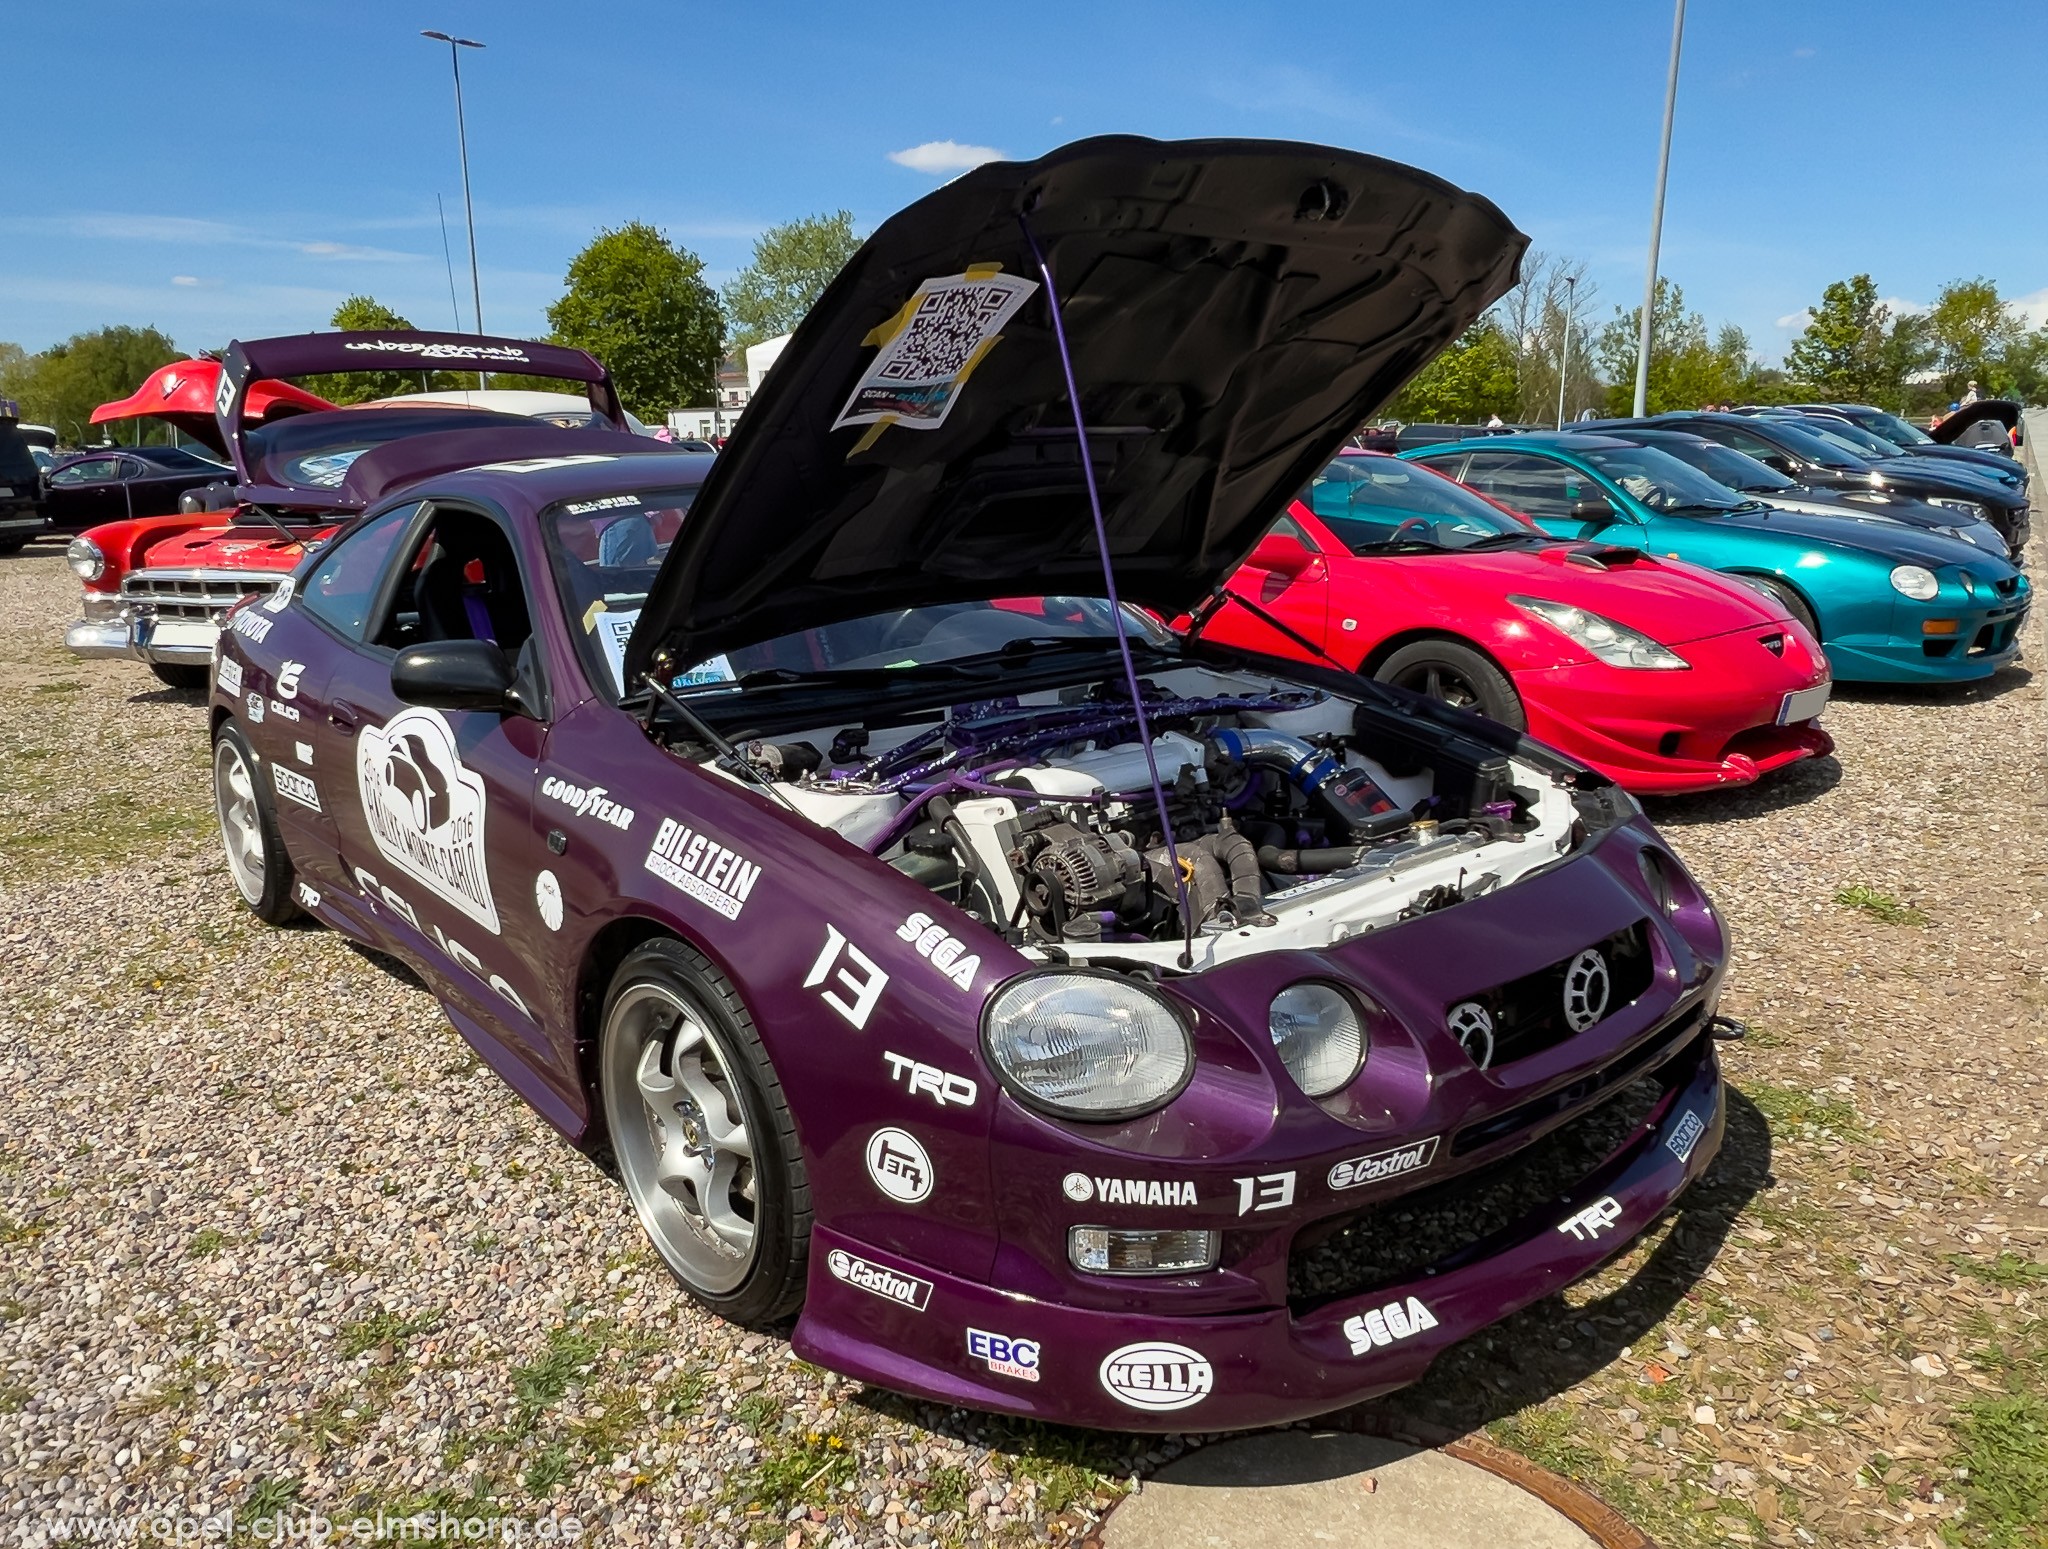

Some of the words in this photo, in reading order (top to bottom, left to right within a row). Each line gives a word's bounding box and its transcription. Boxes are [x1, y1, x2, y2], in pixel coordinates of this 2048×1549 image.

[542, 776, 635, 831] GOODYEAR
[451, 811, 473, 844] 2016
[652, 817, 762, 903] BILSTEIN
[649, 855, 678, 881] SHOCK
[678, 874, 738, 915] ABSORBERS
[895, 912, 982, 993] SEGA
[803, 922, 890, 1030] 13
[884, 1050, 978, 1106] TRD
[1670, 1113, 1699, 1154] sparco
[1354, 1144, 1426, 1182] Castrol
[1094, 1177, 1198, 1206] YAMAHA
[1233, 1171, 1297, 1217] 13
[1557, 1196, 1623, 1241] TRD
[849, 1260, 918, 1304] Castrol
[1343, 1296, 1439, 1357] SEGA
[970, 1331, 1037, 1369] EBC
[989, 1360, 1037, 1380] BRAKES
[1108, 1362, 1214, 1394] HELLA
